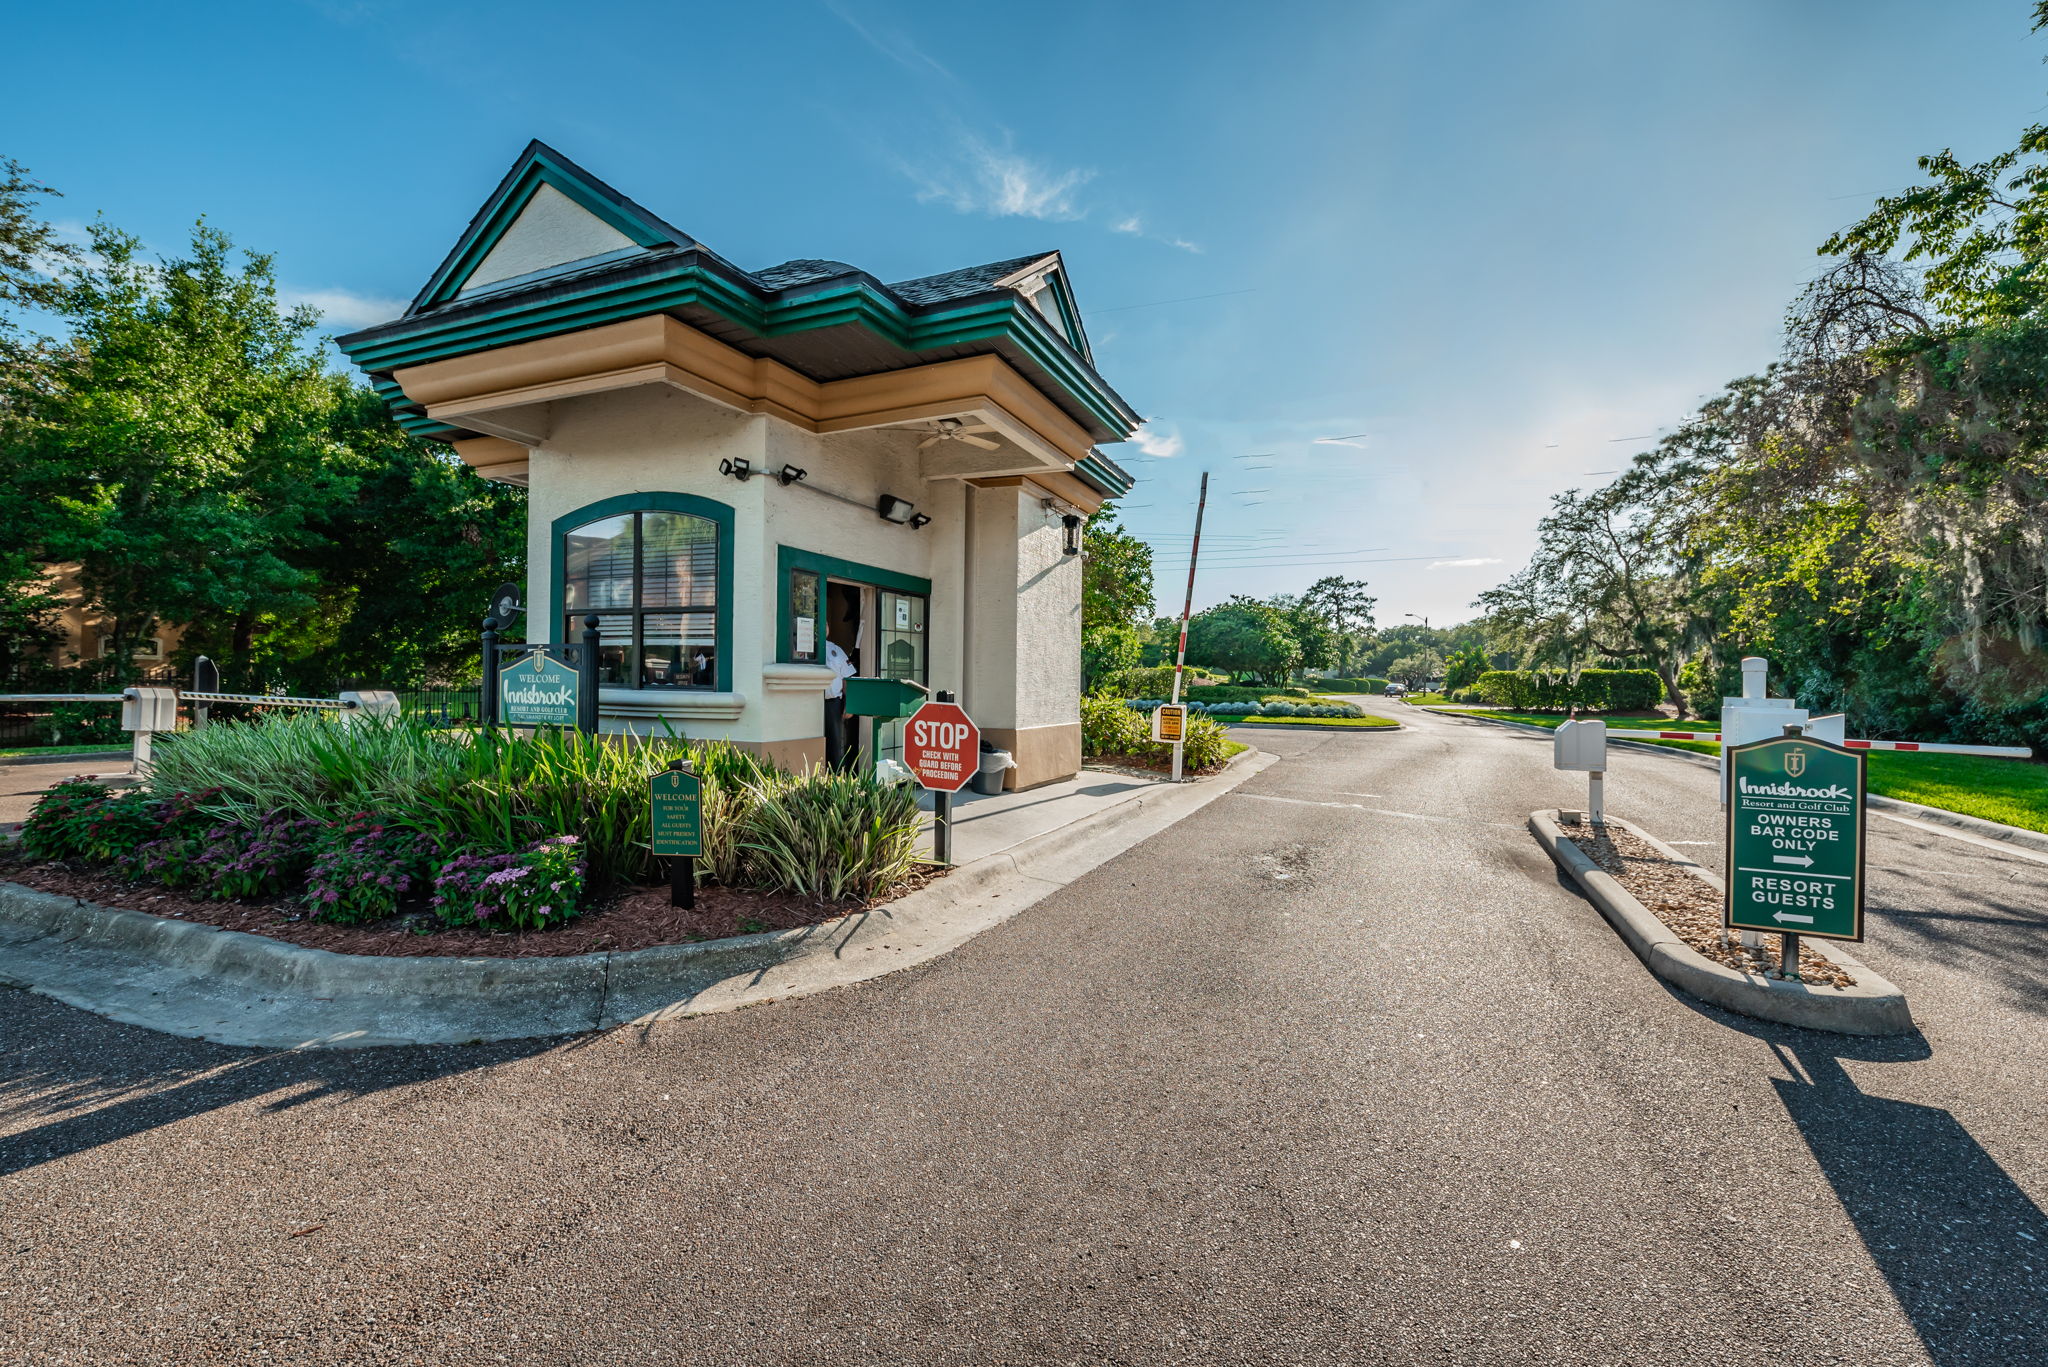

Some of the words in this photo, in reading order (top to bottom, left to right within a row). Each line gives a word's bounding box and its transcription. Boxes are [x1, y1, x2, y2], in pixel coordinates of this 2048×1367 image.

[518, 674, 561, 684] WELCOME
[503, 679, 575, 706] Innisbrook
[914, 720, 968, 749] STOP
[922, 750, 941, 759] CHECK
[943, 752, 959, 761] WITH
[919, 759, 938, 768] GUARD
[940, 762, 962, 771] BEFORE
[922, 769, 958, 780] PROCEEDING
[1739, 776, 1853, 800] Innisbrook
[655, 793, 697, 801] WELCOME
[1742, 799, 1774, 808] Resort
[1798, 802, 1822, 811] Golf
[1824, 803, 1850, 812] Club
[1757, 814, 1832, 829] OWNERS
[1751, 825, 1786, 837] BAR
[1791, 828, 1839, 841] CODE
[1772, 838, 1816, 851] ONLY
[1752, 876, 1836, 895] RESORT
[1752, 891, 1835, 909] GUESTS
